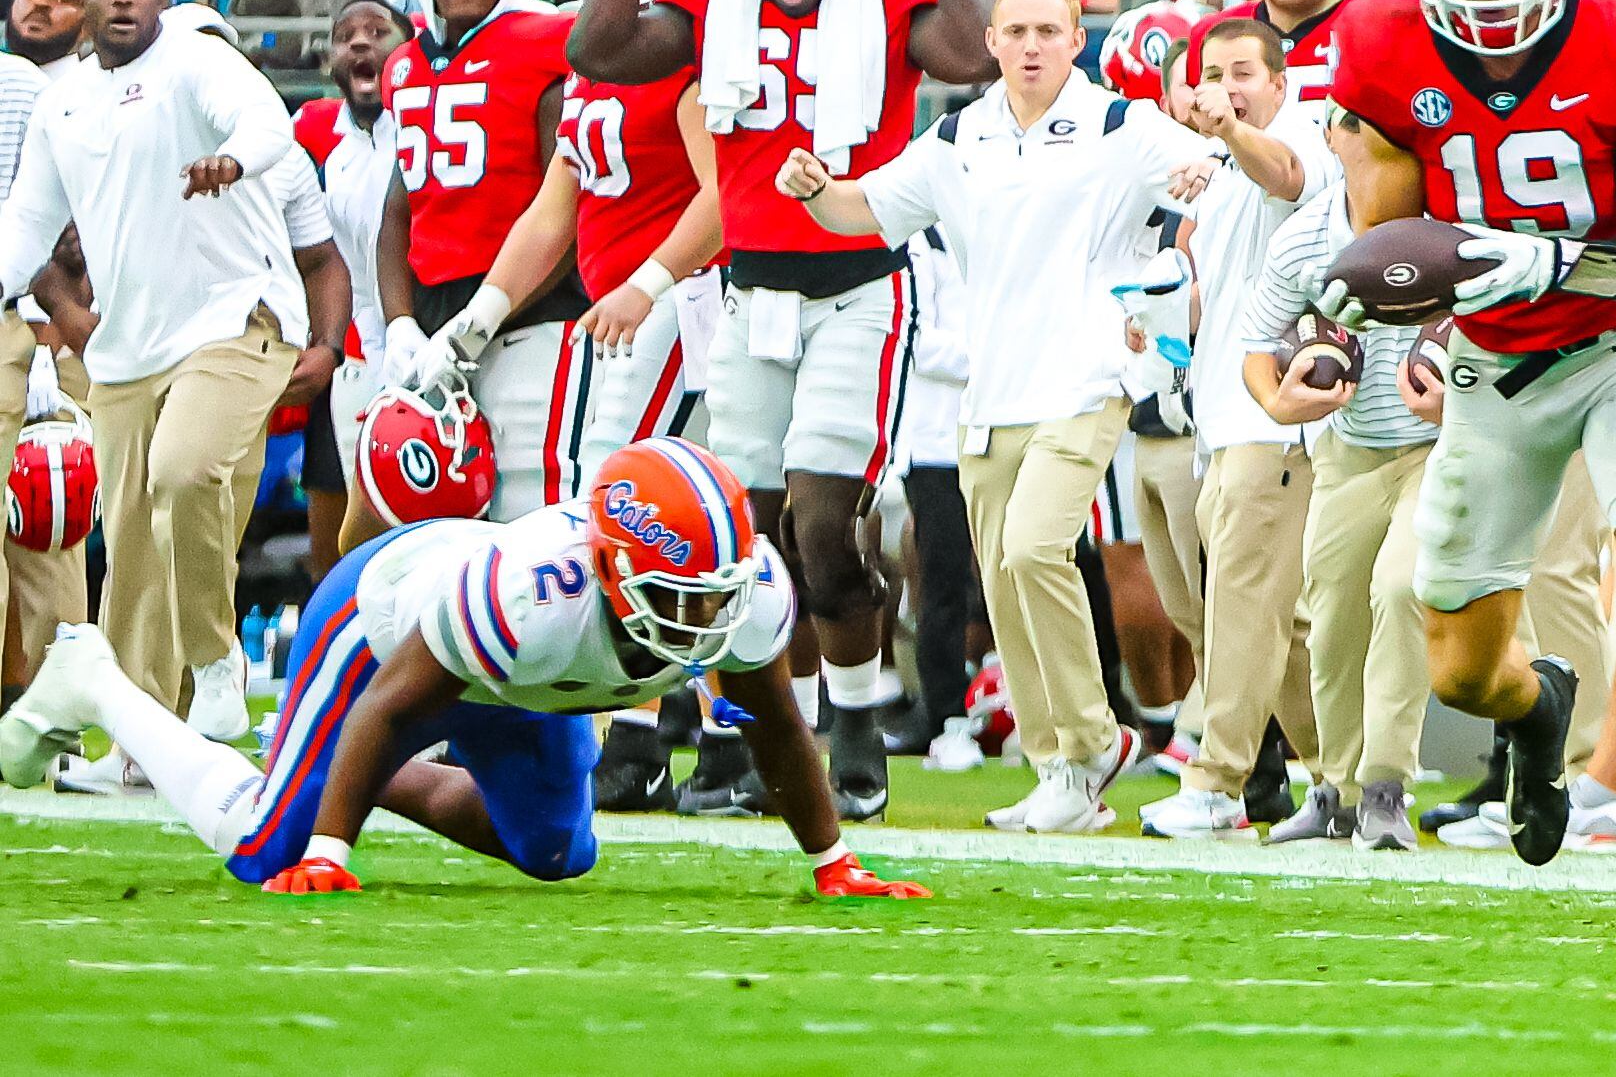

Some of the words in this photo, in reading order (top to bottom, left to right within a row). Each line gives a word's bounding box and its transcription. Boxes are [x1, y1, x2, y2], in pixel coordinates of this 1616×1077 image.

[392, 82, 488, 192] 55
[1049, 119, 1077, 135] G
[1440, 130, 1596, 240] 19
[1451, 365, 1478, 388] G
[605, 479, 691, 566] Gators
[528, 557, 588, 605] 2
